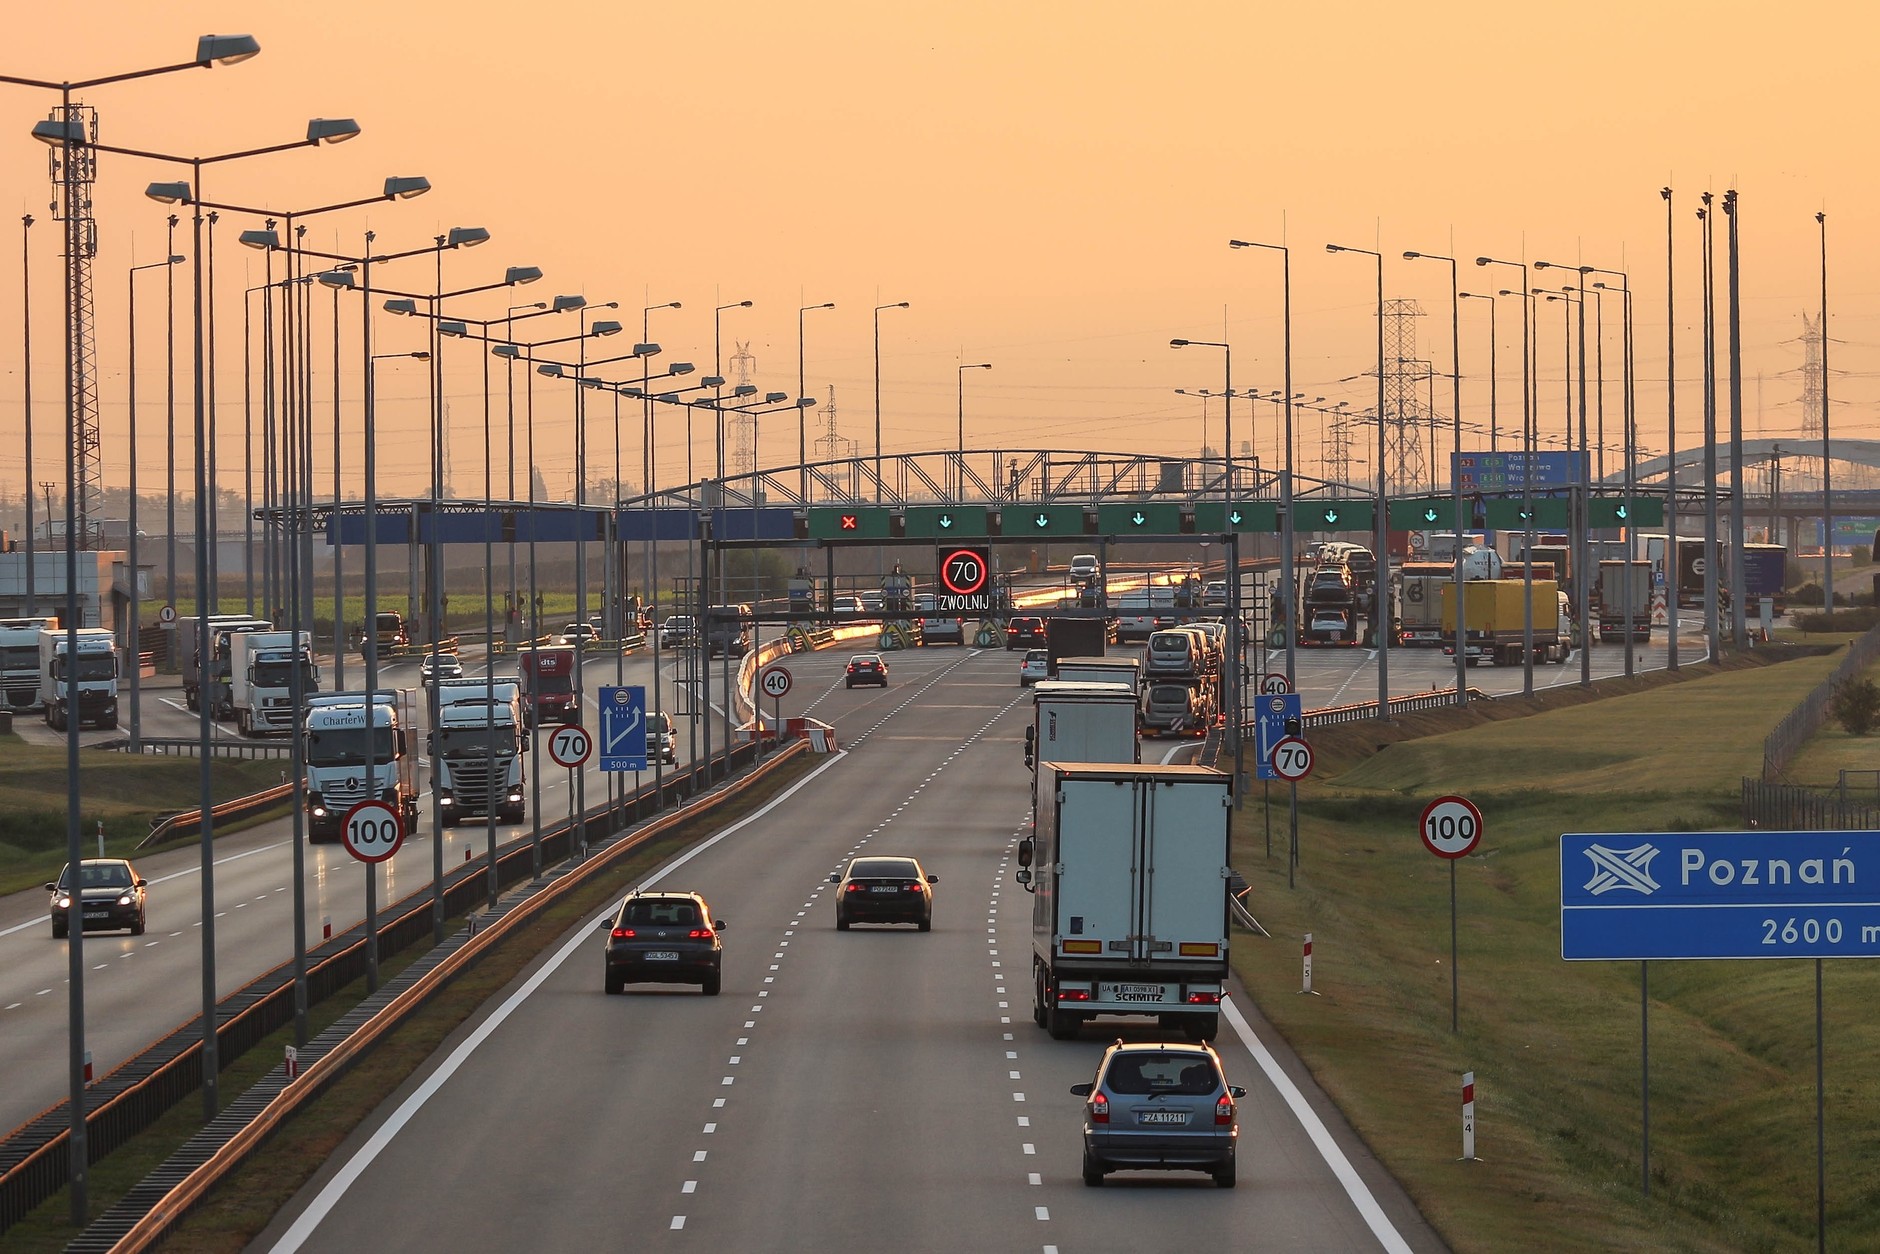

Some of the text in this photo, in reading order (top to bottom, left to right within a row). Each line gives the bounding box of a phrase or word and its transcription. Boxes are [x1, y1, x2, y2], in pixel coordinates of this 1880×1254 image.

[952, 562, 977, 582] 70
[940, 594, 989, 610] ZWOLNIJ
[766, 676, 786, 690] 40
[1266, 682, 1286, 694] 40
[558, 736, 586, 756] 70
[1281, 749, 1308, 770] 70
[350, 820, 396, 844] 100
[1428, 816, 1474, 840] 100
[1681, 846, 1856, 886] Poznań
[1761, 918, 1844, 944] 2600
[1116, 994, 1163, 1002] SCHMITZ
[1144, 1113, 1184, 1122] FZA 11211
[1465, 1124, 1472, 1132] 4
